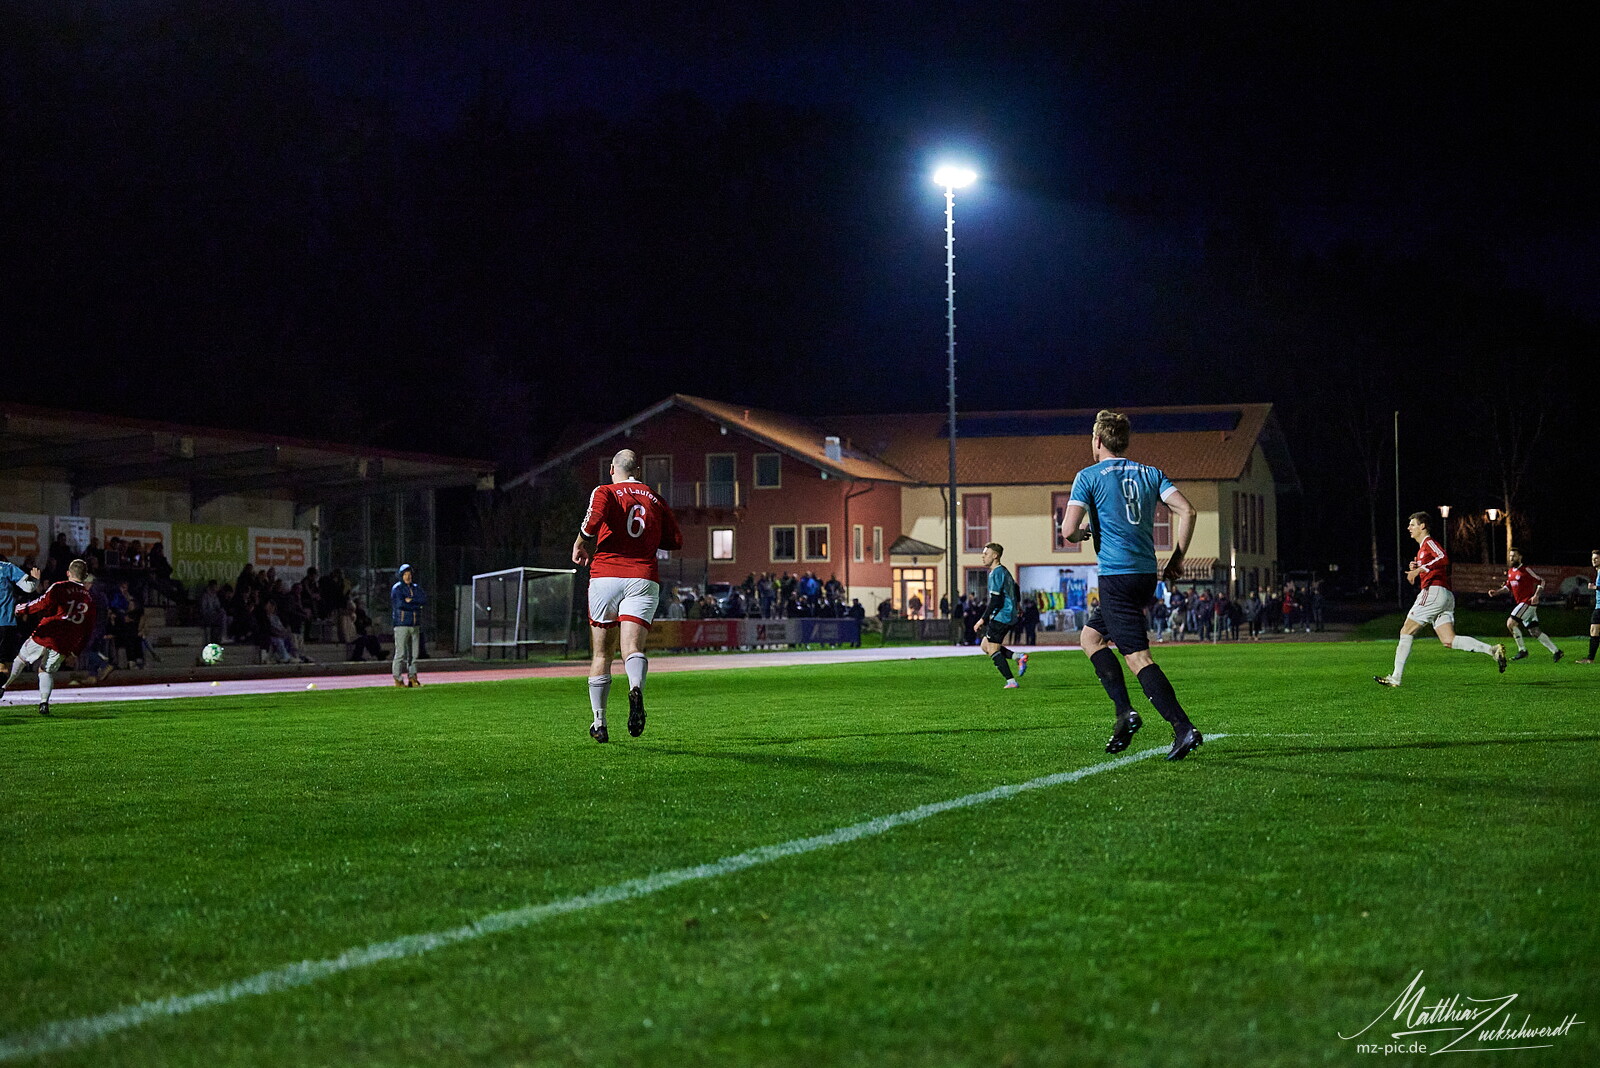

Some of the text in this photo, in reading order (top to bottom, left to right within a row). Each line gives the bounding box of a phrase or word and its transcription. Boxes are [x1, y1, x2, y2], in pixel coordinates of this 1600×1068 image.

[627, 504, 646, 538] 6
[176, 532, 230, 553] ERDGAS
[62, 600, 89, 624] 13
